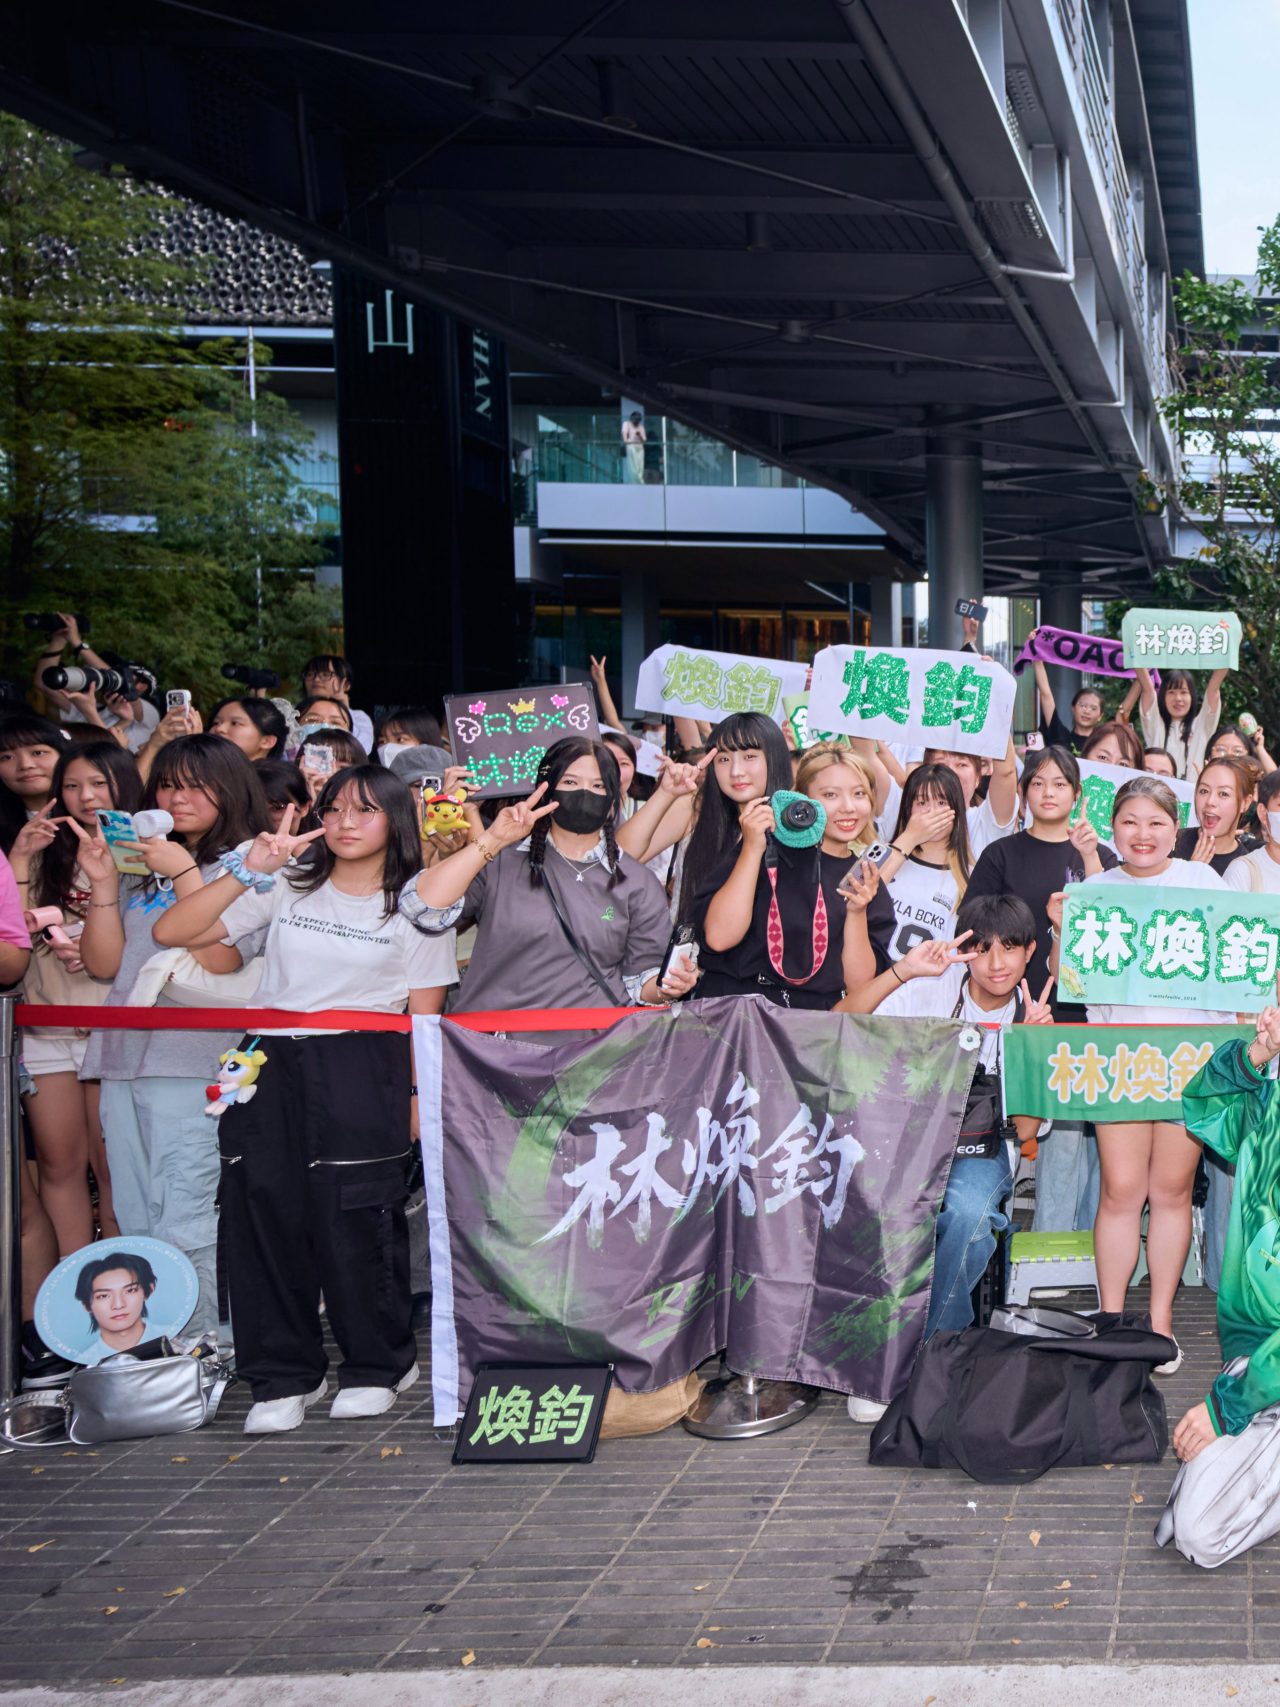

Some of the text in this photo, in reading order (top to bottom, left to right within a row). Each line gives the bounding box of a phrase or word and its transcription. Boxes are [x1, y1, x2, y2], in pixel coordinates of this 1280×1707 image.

[366, 289, 414, 354] 山
[473, 328, 492, 422] HAN
[1135, 623, 1229, 656] 林煥鈞
[661, 650, 783, 717] 煥鈞
[839, 650, 994, 734] 煥鈞
[532, 1071, 865, 1250] 林煥鈞
[956, 1142, 986, 1155] EOS
[468, 1383, 595, 1446] 煥鈞
